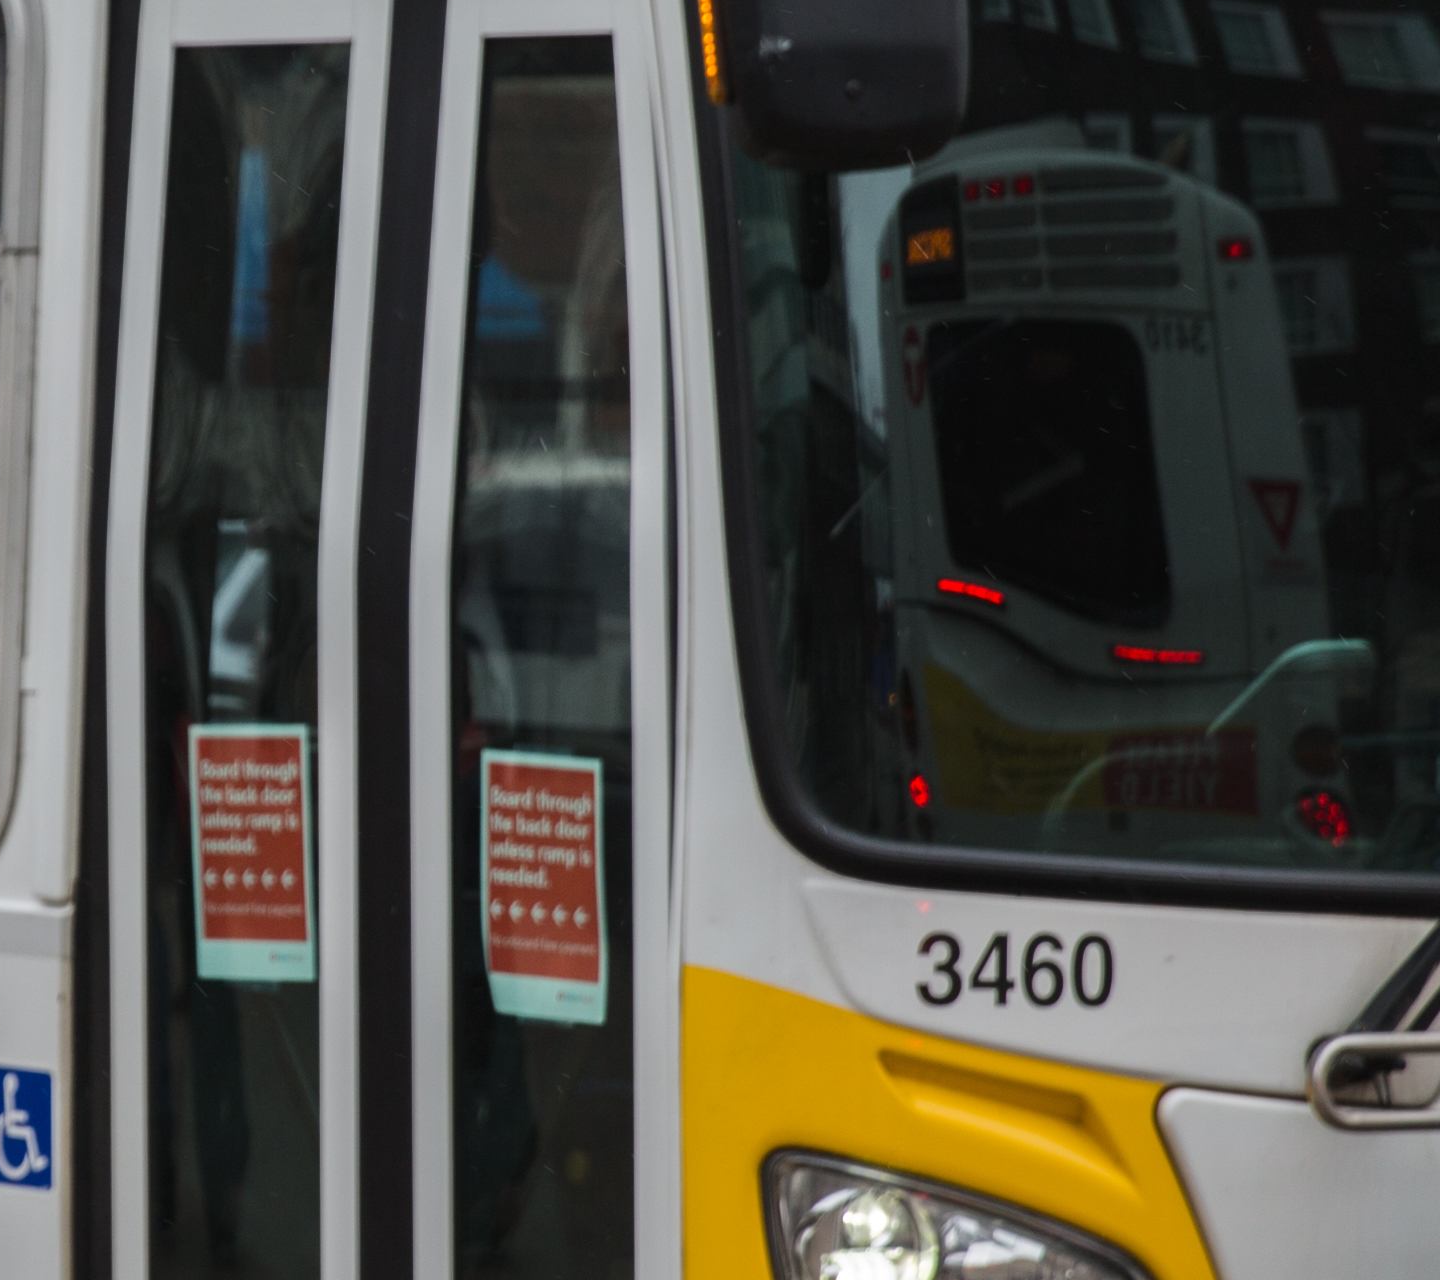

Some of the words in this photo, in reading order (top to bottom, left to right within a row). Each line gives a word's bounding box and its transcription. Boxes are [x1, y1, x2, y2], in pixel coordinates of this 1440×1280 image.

[200, 759, 239, 780] Board
[241, 759, 297, 785] through
[261, 784, 294, 805] door
[490, 785, 534, 810] Board
[536, 788, 592, 820] through
[554, 816, 591, 840] door
[915, 932, 1115, 1008] 3460
